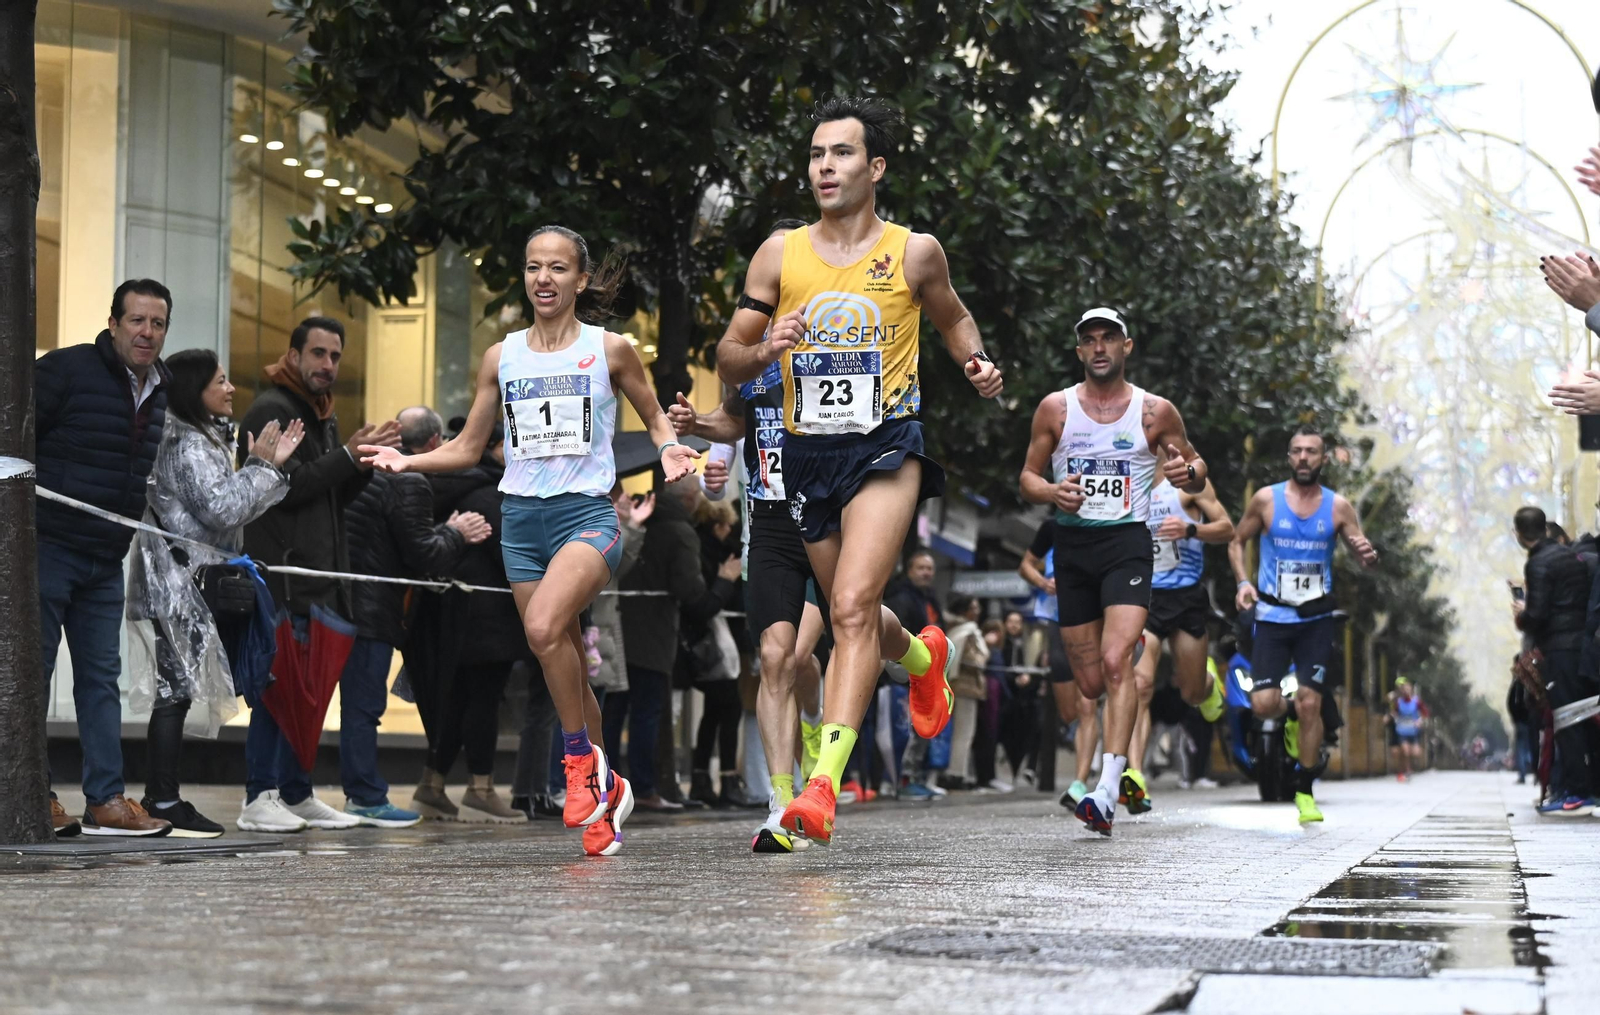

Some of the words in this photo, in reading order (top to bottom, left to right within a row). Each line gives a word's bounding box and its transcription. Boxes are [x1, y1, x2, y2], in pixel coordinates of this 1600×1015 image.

[802, 326, 840, 343] nica
[846, 325, 899, 343] SENT
[831, 352, 862, 360] MEDIA
[802, 362, 816, 374] 59
[543, 376, 572, 384] MEDIA
[512, 386, 528, 400] 59
[818, 380, 854, 406] 23
[539, 401, 552, 426] 1
[754, 408, 776, 420] CLUB
[767, 452, 782, 474] 2
[1085, 478, 1122, 498] 548
[1150, 506, 1171, 517] ENA
[1152, 539, 1160, 554] 5
[1293, 576, 1310, 590] 14
